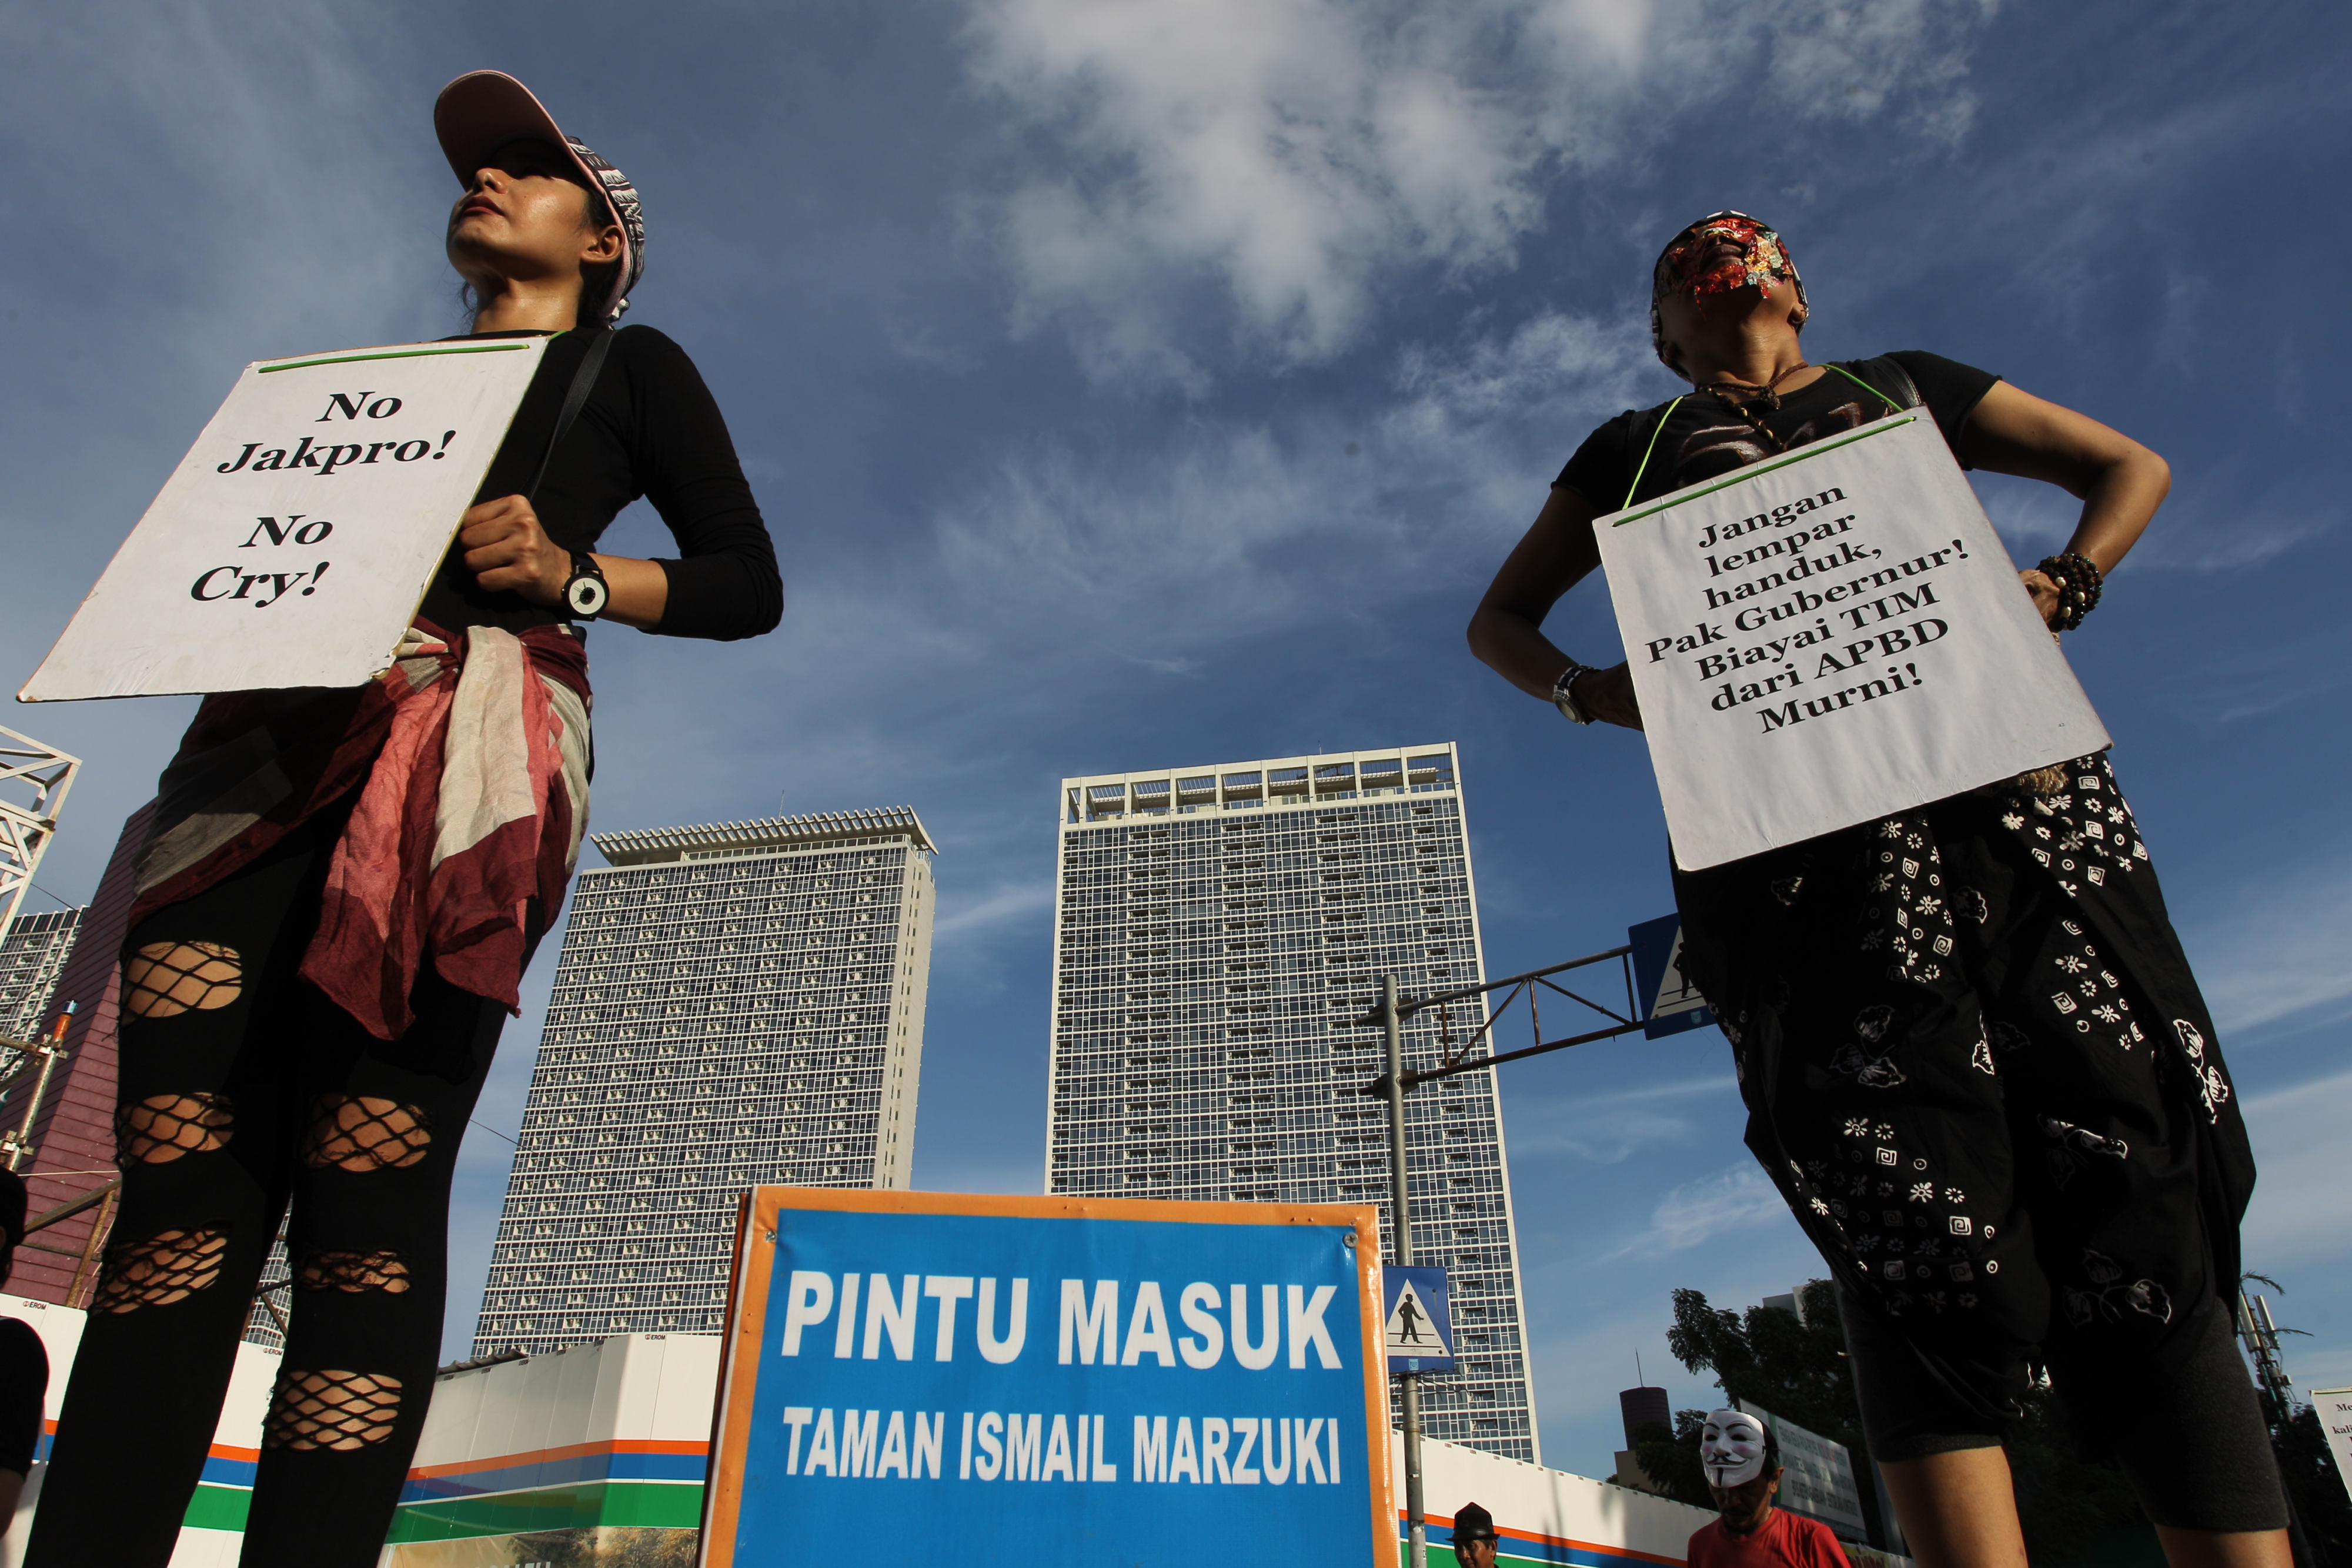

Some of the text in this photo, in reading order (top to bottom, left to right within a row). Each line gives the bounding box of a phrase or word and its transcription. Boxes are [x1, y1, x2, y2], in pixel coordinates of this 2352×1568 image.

[315, 391, 402, 422] No
[217, 430, 456, 476] Jakpro!
[238, 514, 333, 548] No
[1699, 487, 1847, 548] Jangan
[1704, 514, 1856, 577] lempar
[191, 561, 330, 608] Cry!
[1645, 539, 1969, 663] Pak Gubernur!
[1702, 542, 1882, 610] handuk,
[1694, 582, 1940, 681] Biayai TIM
[1711, 618, 1948, 711] dari APBD
[1756, 663, 1922, 734] Murni!
[781, 1271, 1342, 1370] PINTU MASUK
[783, 1407, 1340, 1485] TAMAN ISMAIL MARZUKI
